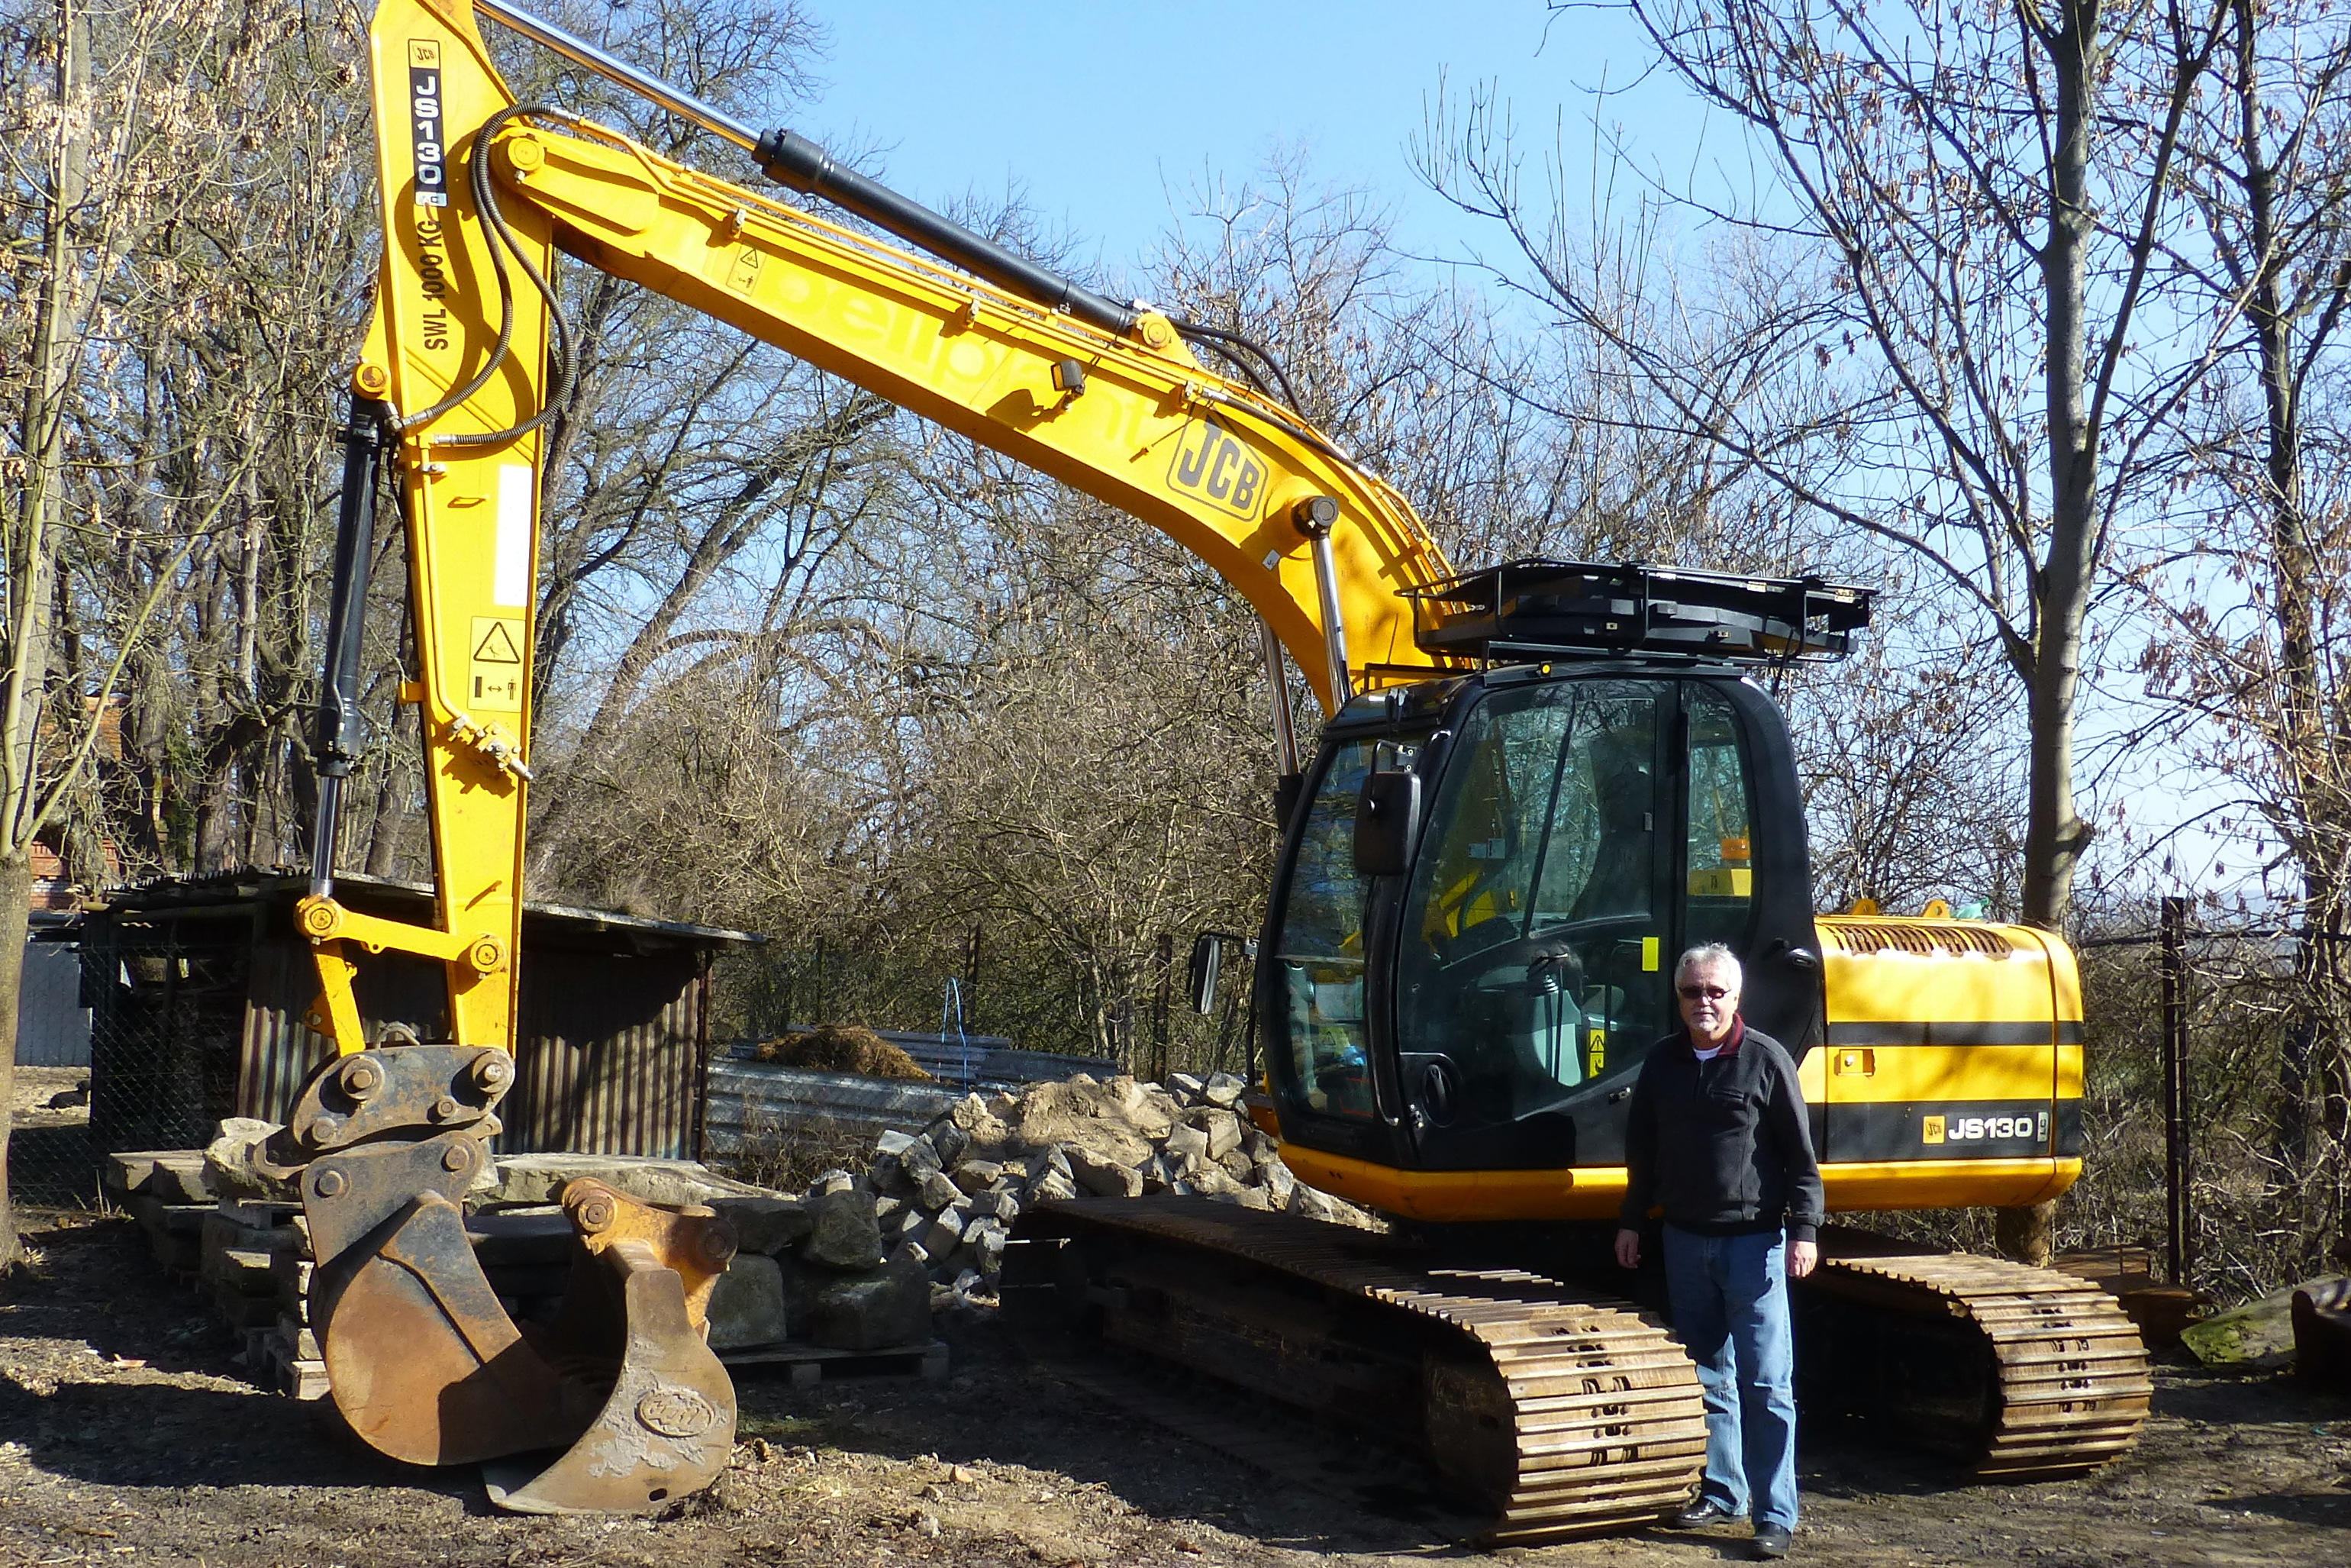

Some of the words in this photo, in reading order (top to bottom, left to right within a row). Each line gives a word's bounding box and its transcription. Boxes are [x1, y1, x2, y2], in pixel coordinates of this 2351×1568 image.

[417, 47, 435, 61] JCB
[414, 76, 442, 185] JS130
[417, 220, 442, 247] KG
[420, 254, 446, 302] 1000
[423, 308, 448, 350] SWL
[1177, 415, 1259, 510] JCB
[1948, 1117, 2033, 1140] JS130
